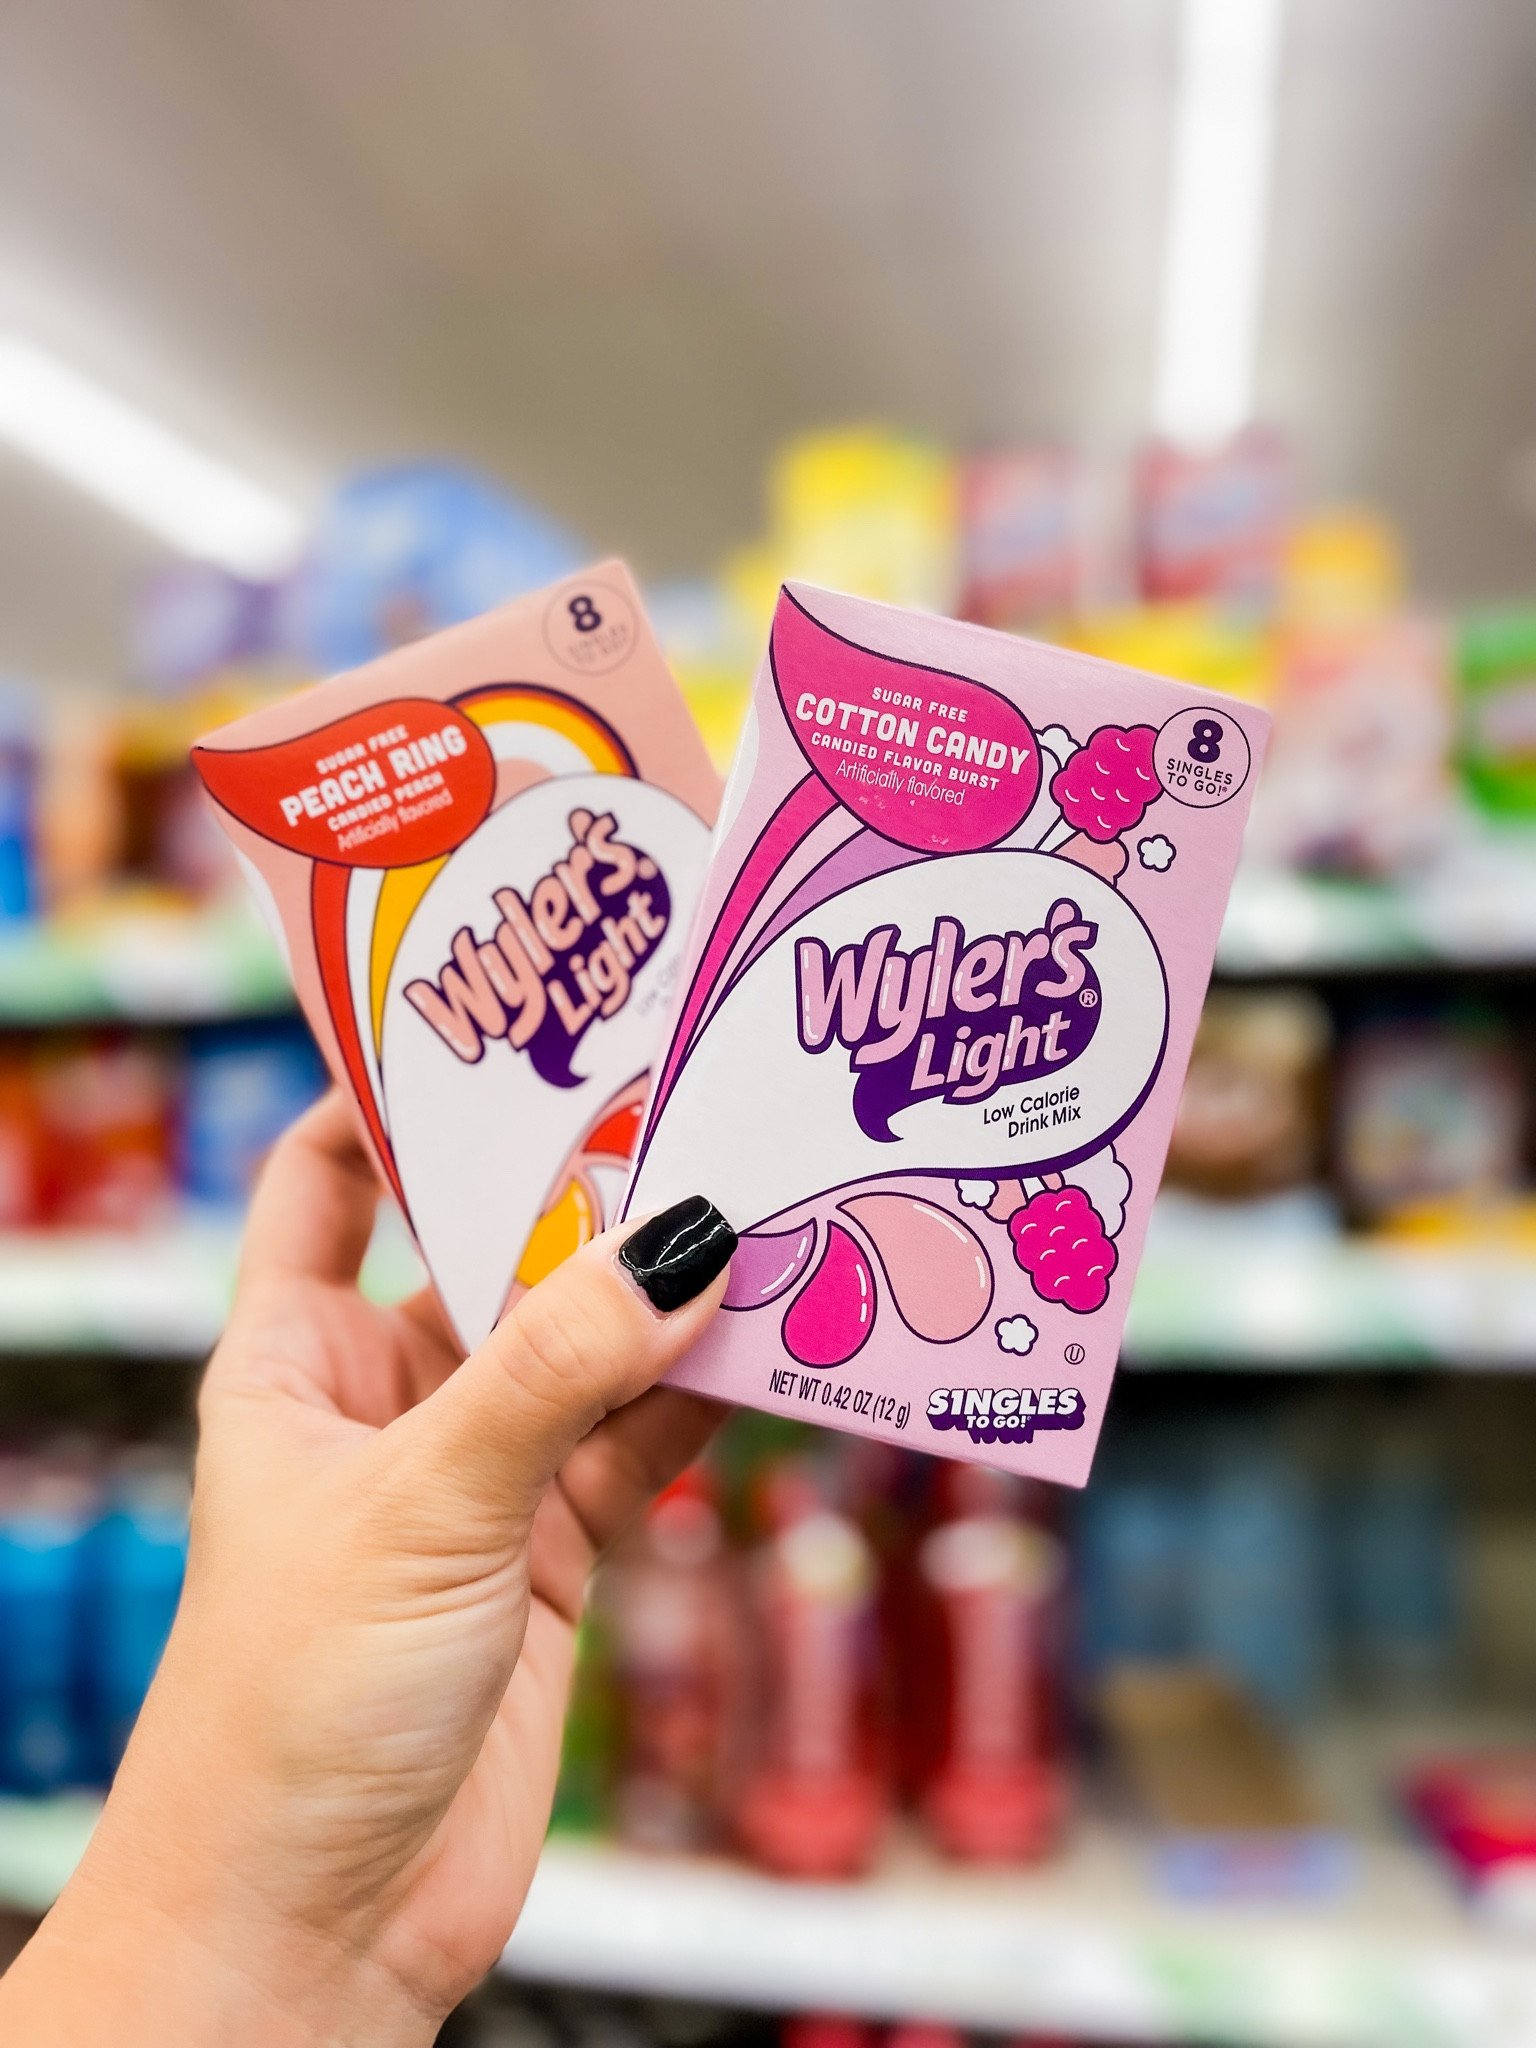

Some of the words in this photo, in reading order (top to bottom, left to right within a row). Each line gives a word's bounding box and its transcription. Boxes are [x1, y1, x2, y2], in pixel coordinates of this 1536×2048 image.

[568, 595, 602, 632] 8
[872, 687, 923, 712] SUGAR
[928, 701, 969, 723] FREE
[316, 743, 367, 774] SUGAR
[368, 724, 408, 752] FREE
[795, 692, 920, 748] COTTON
[926, 726, 1030, 775] CANDY
[1187, 719, 1223, 763] 8
[279, 759, 387, 827] PEACH
[387, 725, 467, 780] RING
[811, 732, 878, 760] CANDIED
[883, 750, 943, 777] FLAVOR
[948, 767, 1000, 791] BURST
[835, 759, 905, 795] Artificially
[907, 776, 966, 806] flavored
[1166, 758, 1233, 785] SINGLES
[1167, 772, 1188, 787] TO
[327, 794, 393, 831] CANDIED
[394, 771, 444, 802] PEACH
[402, 807, 638, 1064] Wyler's
[547, 891, 667, 1036] Light
[794, 897, 1099, 1072] Wyler's
[910, 1010, 1072, 1099] Light
[983, 1104, 1015, 1125] Low
[1020, 1085, 1080, 1114] Calorie
[1008, 1113, 1049, 1138] Drink
[1052, 1105, 1081, 1126] Mix
[769, 1368, 798, 1396] NET
[799, 1375, 822, 1402] WT
[821, 1382, 852, 1410] 0.42
[853, 1389, 874, 1415] OZ
[872, 1395, 896, 1423] (12
[895, 1402, 911, 1430] g)
[966, 1415, 990, 1429] TO
